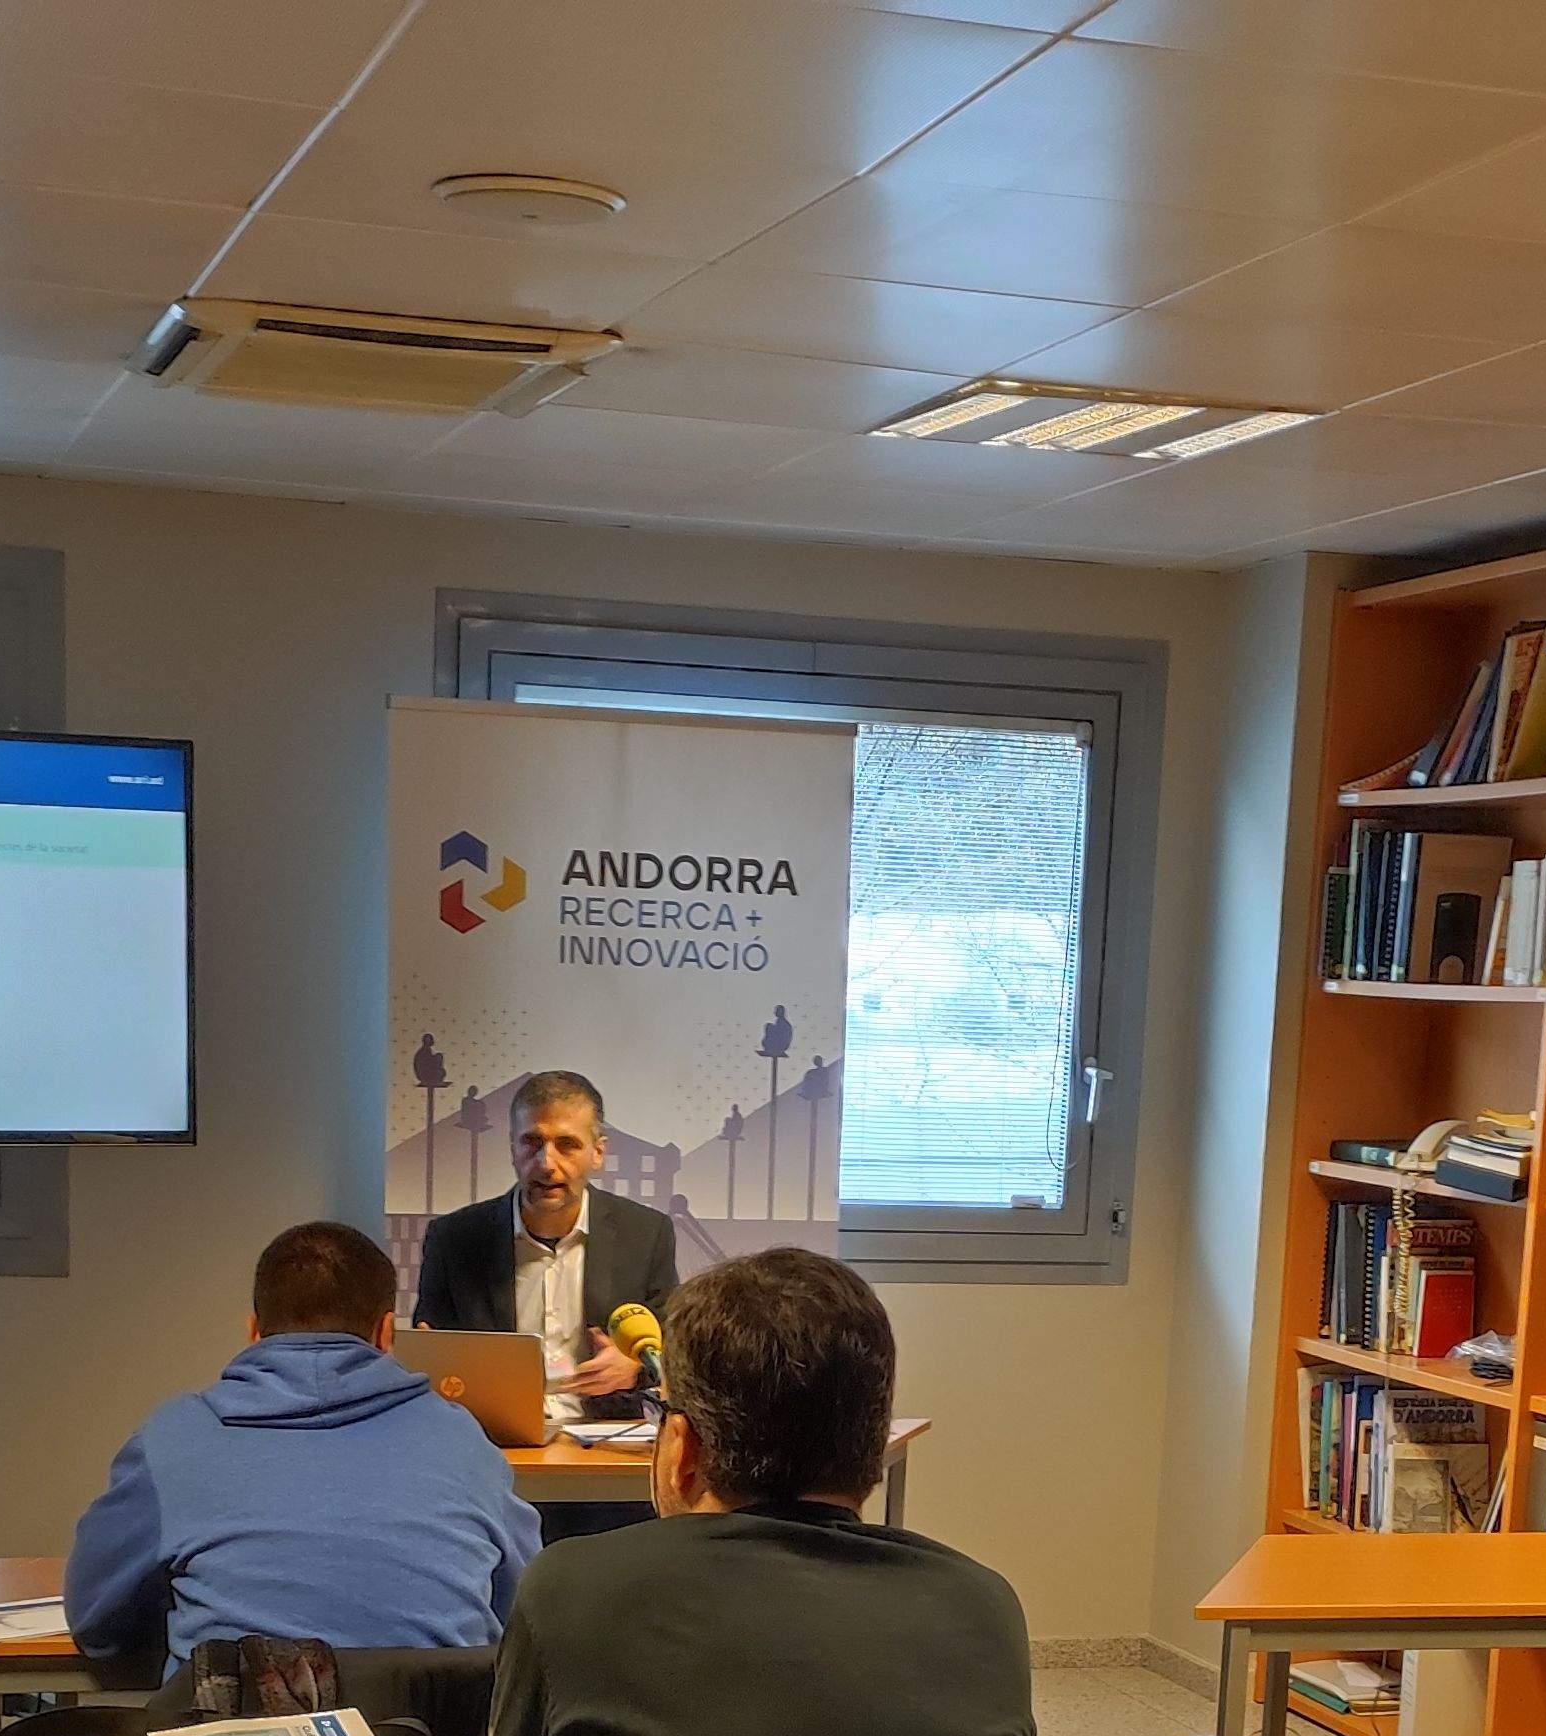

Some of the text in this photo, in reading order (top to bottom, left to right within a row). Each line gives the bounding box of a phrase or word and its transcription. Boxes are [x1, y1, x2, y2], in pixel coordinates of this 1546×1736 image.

[561, 850, 798, 896] ANDORRA
[559, 896, 737, 932] RECERCA
[559, 935, 769, 972] INNOVACIÓ
